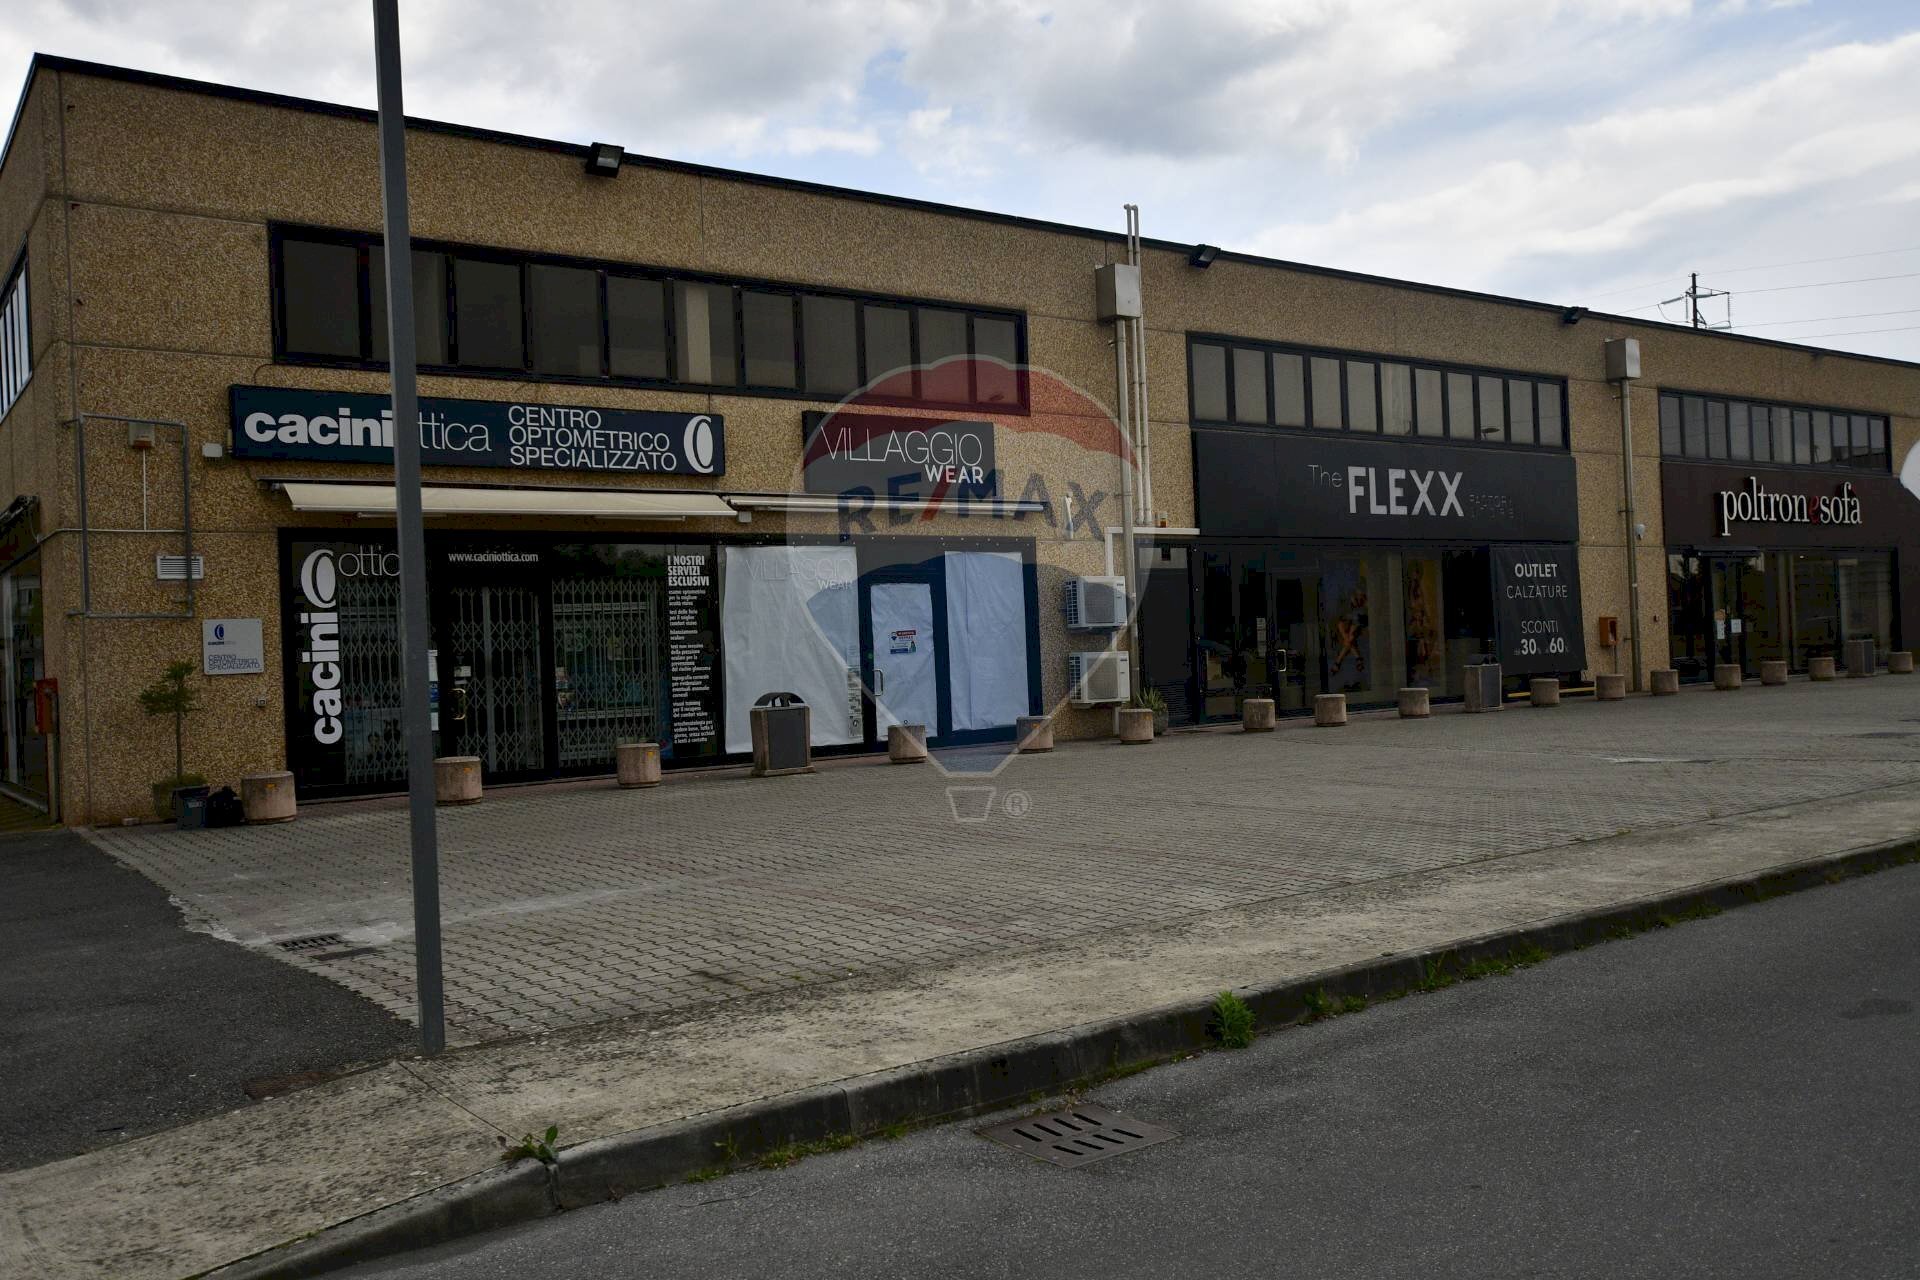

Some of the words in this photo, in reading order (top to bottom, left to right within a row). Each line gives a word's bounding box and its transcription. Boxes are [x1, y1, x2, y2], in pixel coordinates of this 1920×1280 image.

[508, 405, 602, 429] CENTRO
[508, 425, 670, 452] OPTOMETRICO
[821, 425, 983, 466] VILLAGGIO
[510, 446, 677, 471] SPECIALIZZATO
[925, 464, 984, 484] WEAR
[1307, 464, 1343, 488] The
[1347, 465, 1465, 517] FLEXX
[447, 551, 539, 562] www.caciniottica.com
[667, 555, 671, 566] I
[673, 555, 705, 566] NOSTRI
[667, 565, 701, 576] SERVIZI
[1514, 563, 1558, 578] OUTLET
[668, 575, 710, 587] ESCLUSIVI
[1506, 584, 1568, 599] CALZATURE
[1521, 619, 1558, 634] SCONTI
[300, 611, 343, 744] cacini
